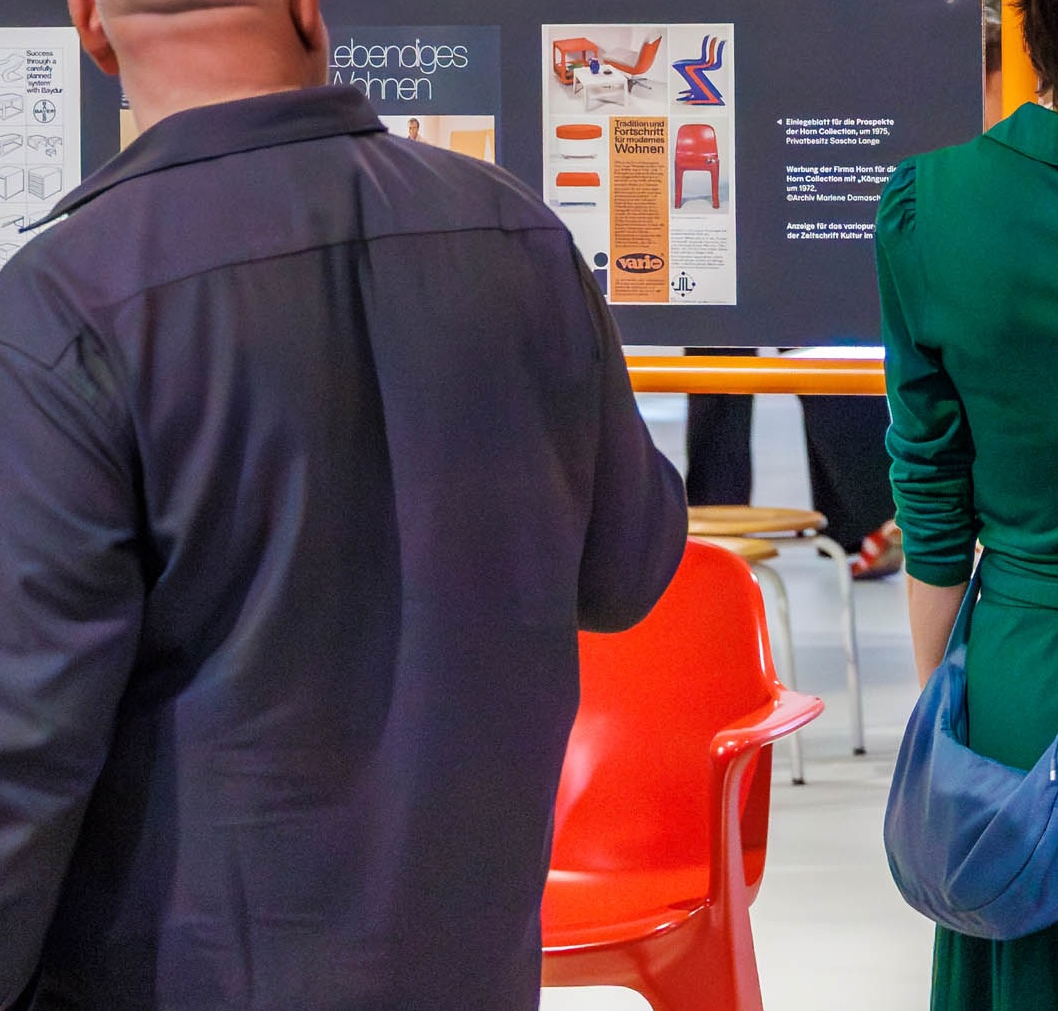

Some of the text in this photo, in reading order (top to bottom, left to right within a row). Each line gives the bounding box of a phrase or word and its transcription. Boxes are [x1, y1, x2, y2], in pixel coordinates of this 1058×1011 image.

[785, 118, 830, 127] Einlegeblatt
[856, 118, 894, 126] Prospekte
[614, 127, 664, 136] Fortschritt
[818, 127, 858, 136] Collection,
[872, 127, 890, 135] 1975,
[626, 136, 665, 144] modernes
[785, 137, 880, 145] Privatbesitz Sascha Lange
[614, 144, 665, 154] Wohnen
[786, 165, 819, 174] Werbung
[855, 165, 874, 173] Horn
[874, 165, 886, 173] für
[799, 184, 817, 192] 1972,
[786, 222, 816, 231] Anzeige
[828, 222, 843, 230] das
[618, 255, 663, 270] vario
